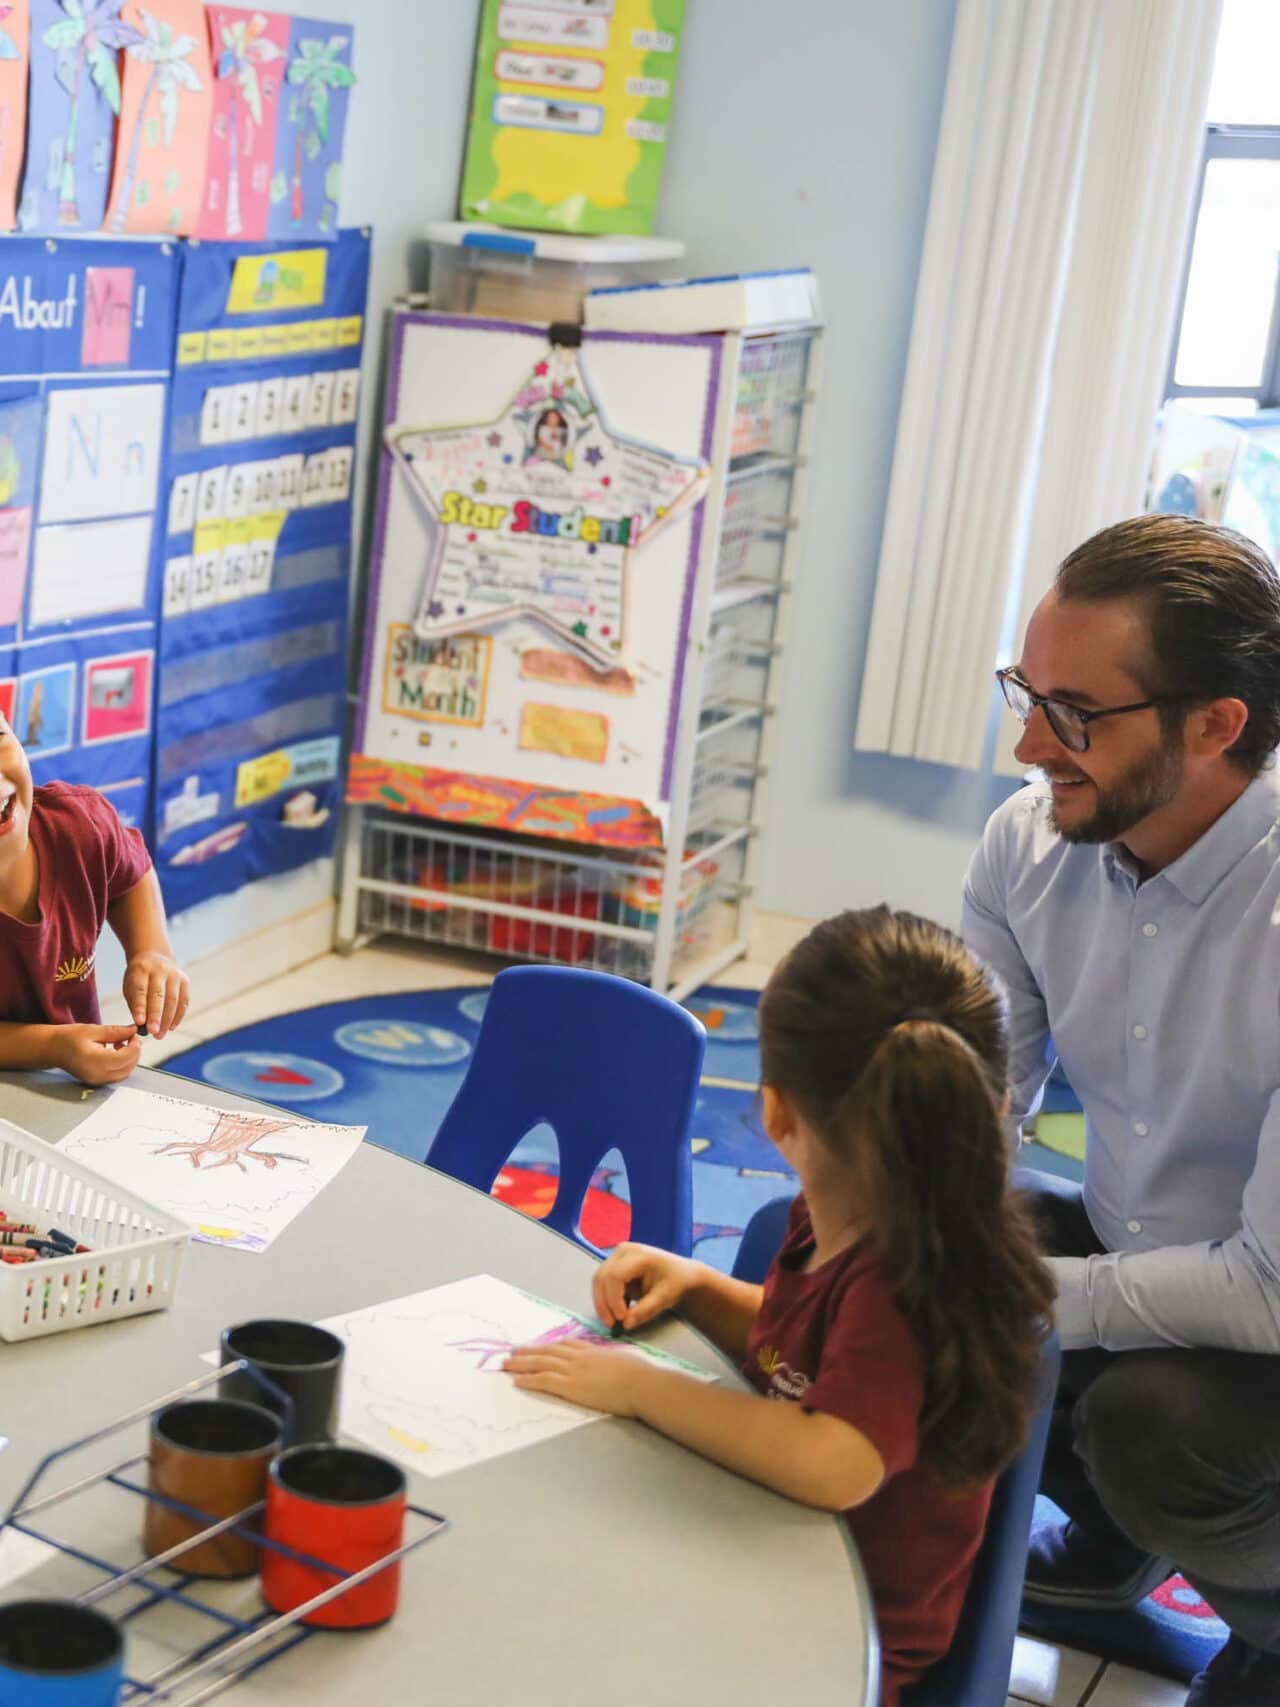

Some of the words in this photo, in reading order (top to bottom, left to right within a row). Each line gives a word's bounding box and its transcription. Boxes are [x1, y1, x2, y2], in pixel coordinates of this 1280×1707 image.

[439, 491, 508, 529] Star
[510, 499, 641, 547] Student!
[394, 633, 481, 672] Student
[397, 681, 477, 718] Month
